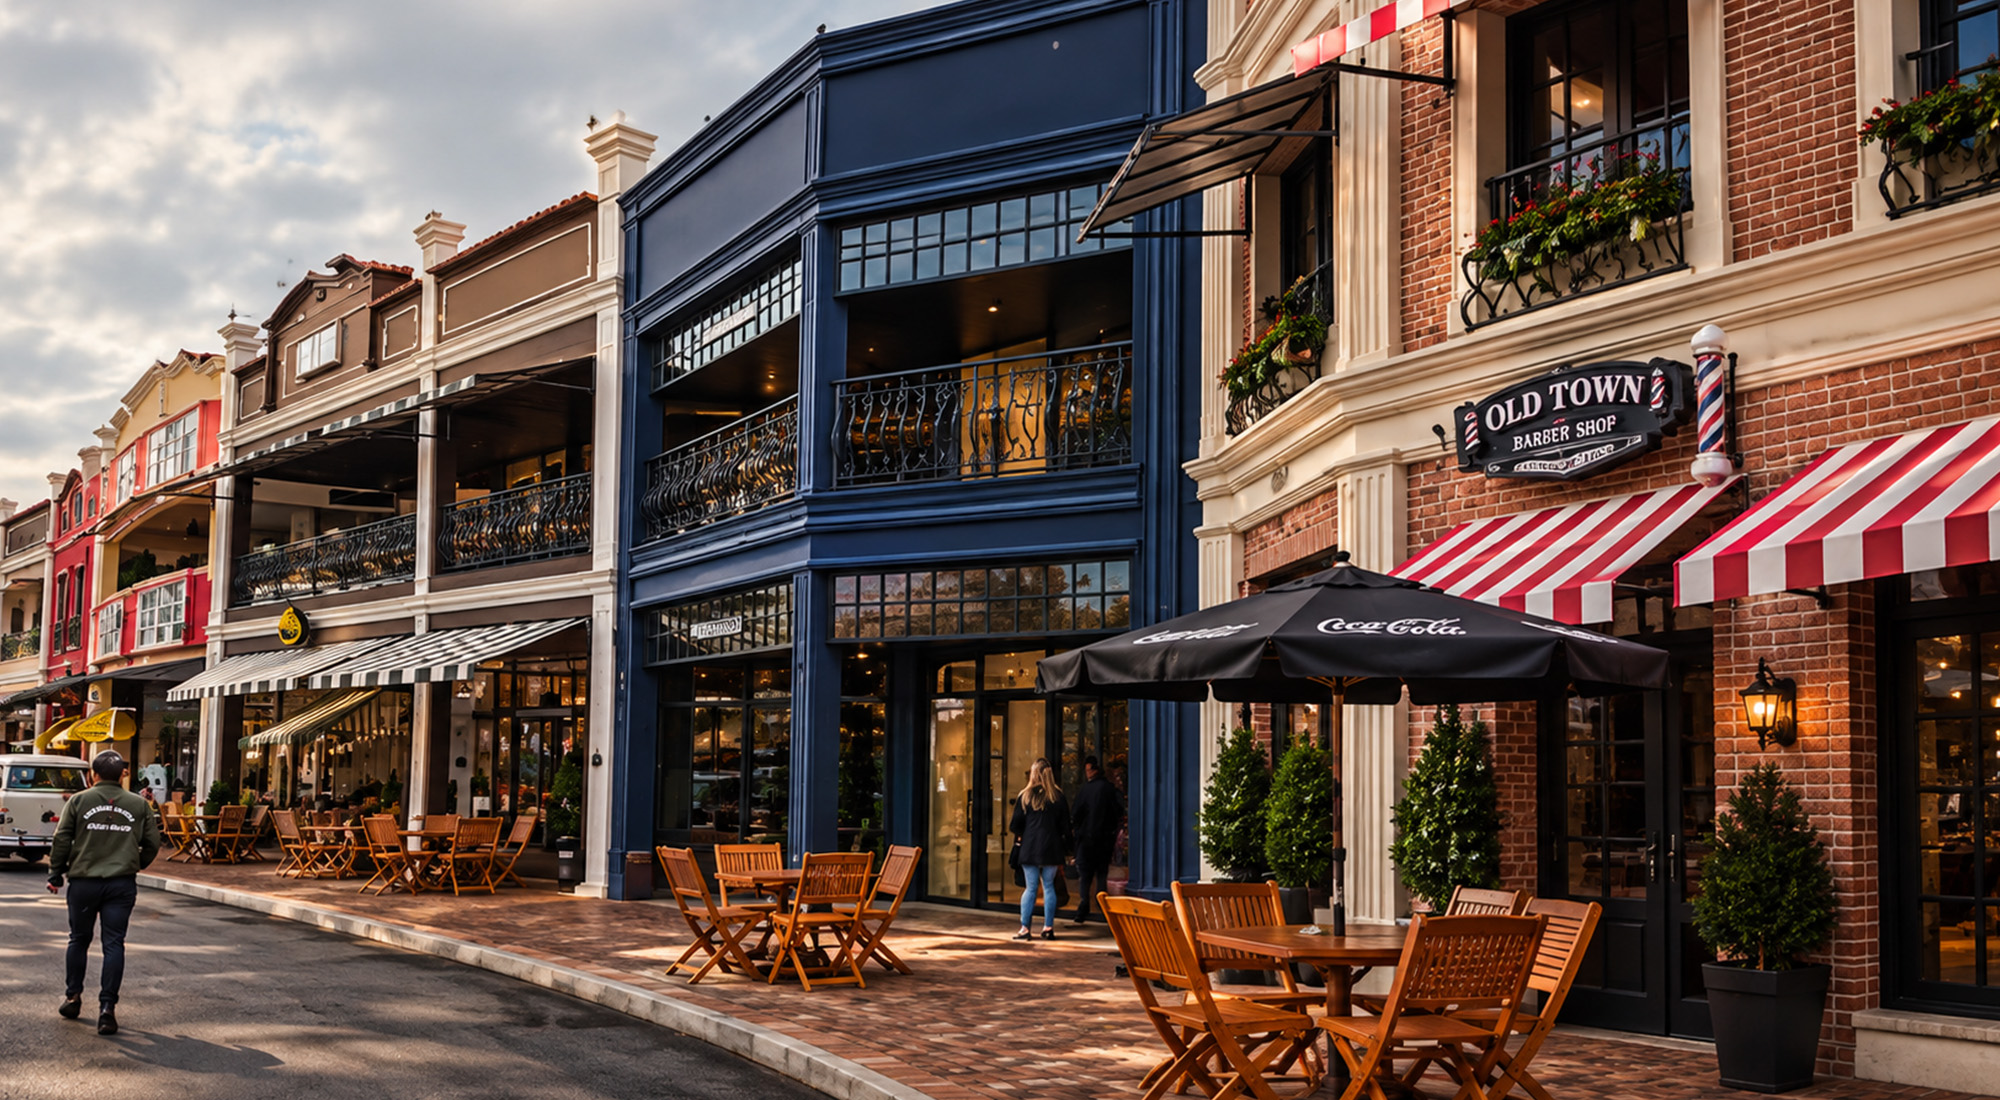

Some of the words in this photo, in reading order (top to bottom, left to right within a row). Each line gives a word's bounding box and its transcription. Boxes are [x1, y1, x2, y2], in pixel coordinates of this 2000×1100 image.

[1485, 391, 1543, 431] OLD
[1549, 375, 1645, 411] TOWN
[1512, 425, 1570, 452] BARBER
[1576, 414, 1617, 438] SHOP
